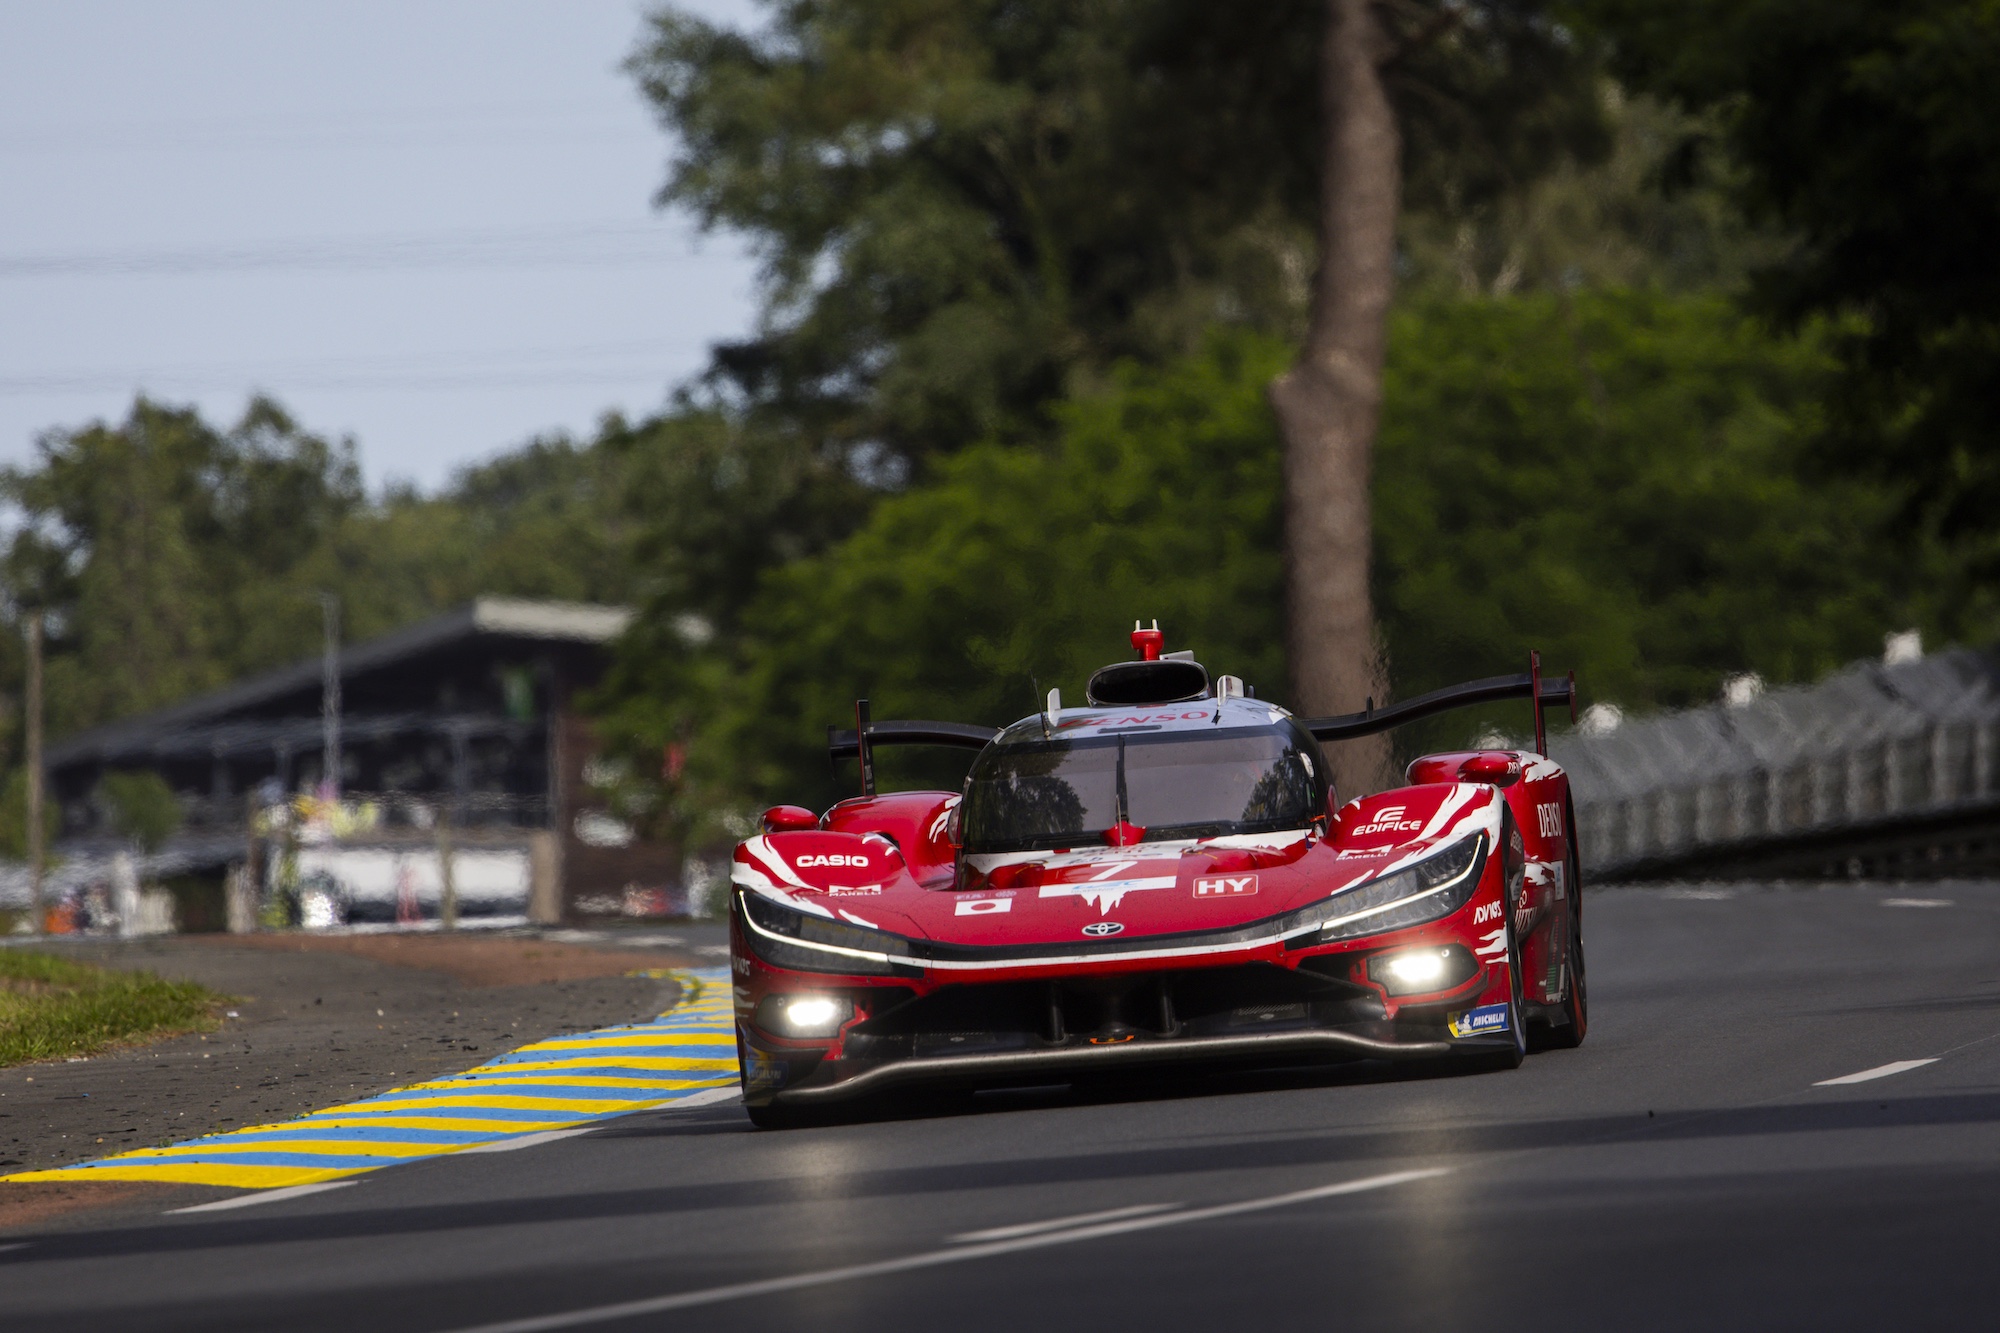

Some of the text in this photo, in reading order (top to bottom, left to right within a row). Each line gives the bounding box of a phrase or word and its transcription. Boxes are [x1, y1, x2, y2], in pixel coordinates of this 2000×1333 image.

[1507, 761, 1521, 774] DEN
[1352, 819, 1422, 837] EDIFICE
[1536, 802, 1562, 838] DENSO
[796, 855, 869, 868] CASIO
[1088, 861, 1139, 881] 7
[1197, 877, 1254, 895] HY
[1472, 1012, 1506, 1028] MICHELIN
